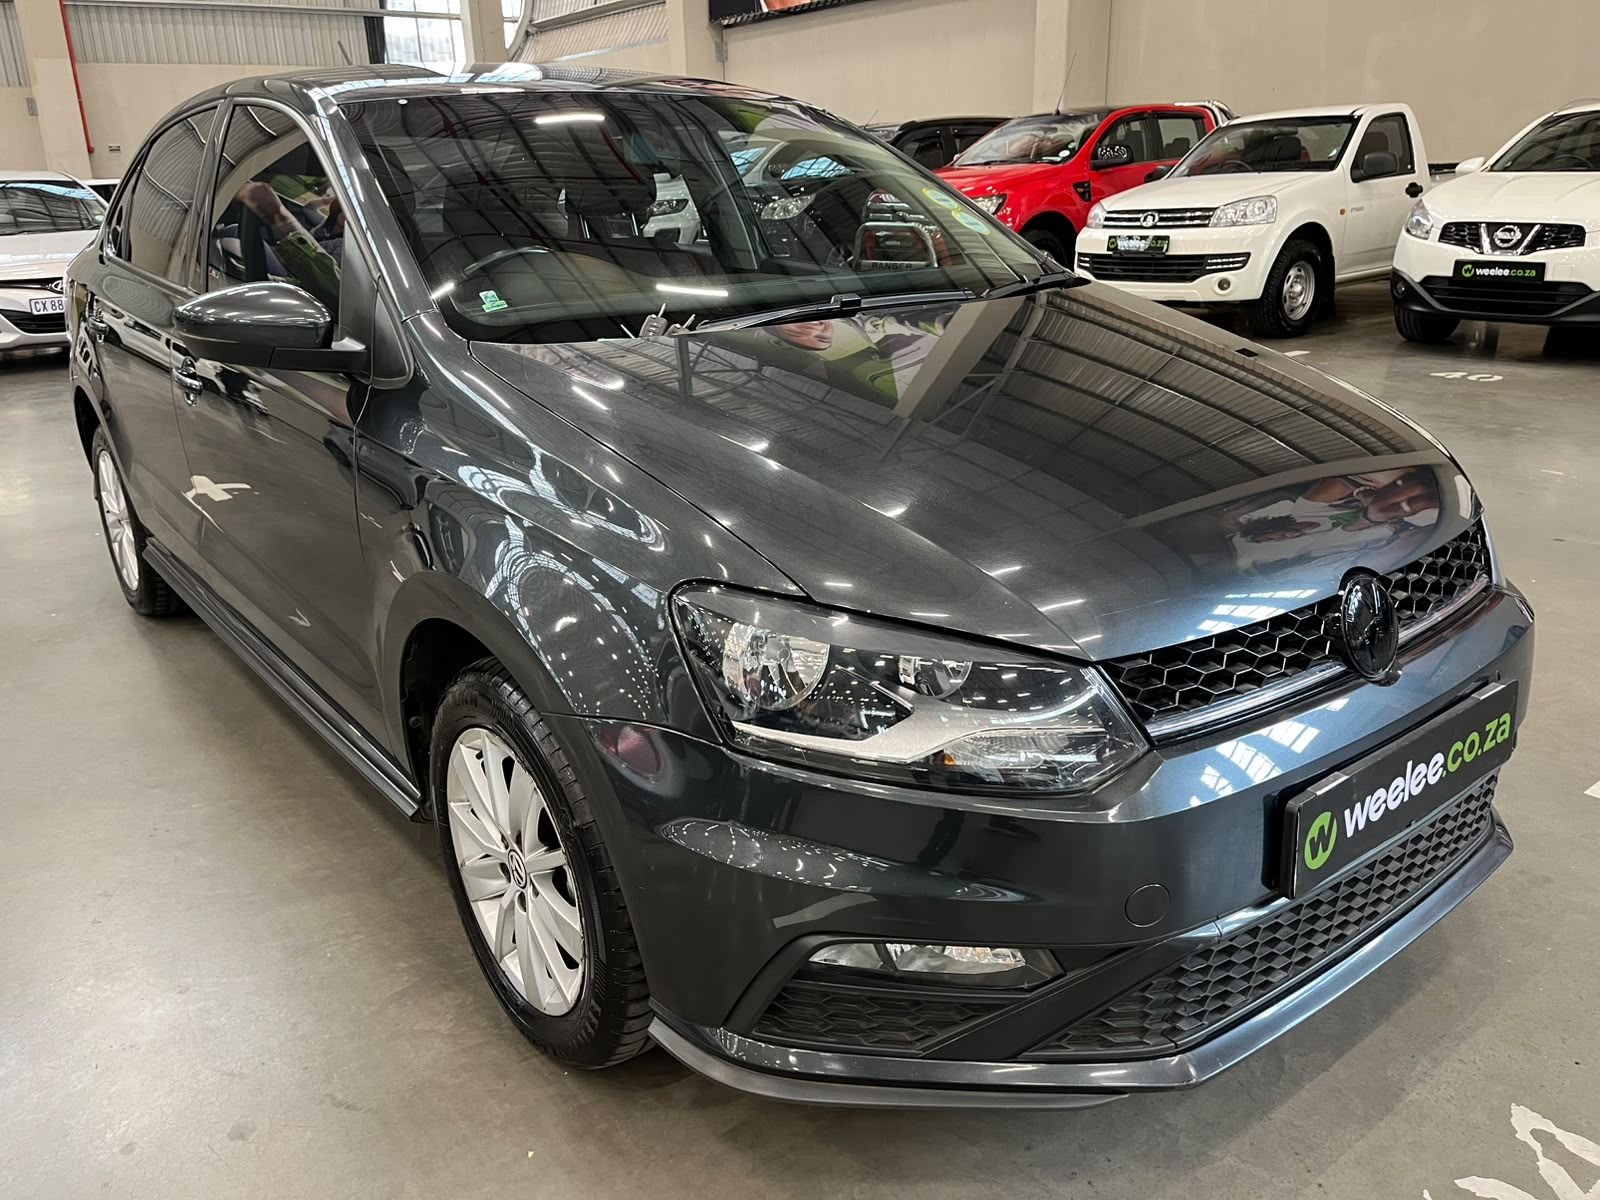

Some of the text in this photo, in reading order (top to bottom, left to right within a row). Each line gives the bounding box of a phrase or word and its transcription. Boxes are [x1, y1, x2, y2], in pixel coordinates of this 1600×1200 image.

[871, 261, 913, 269] RANGER
[1476, 266, 1536, 277] weelee.co.za
[34, 300, 48, 312] CX
[1343, 712, 1511, 838] weelee.co.za
